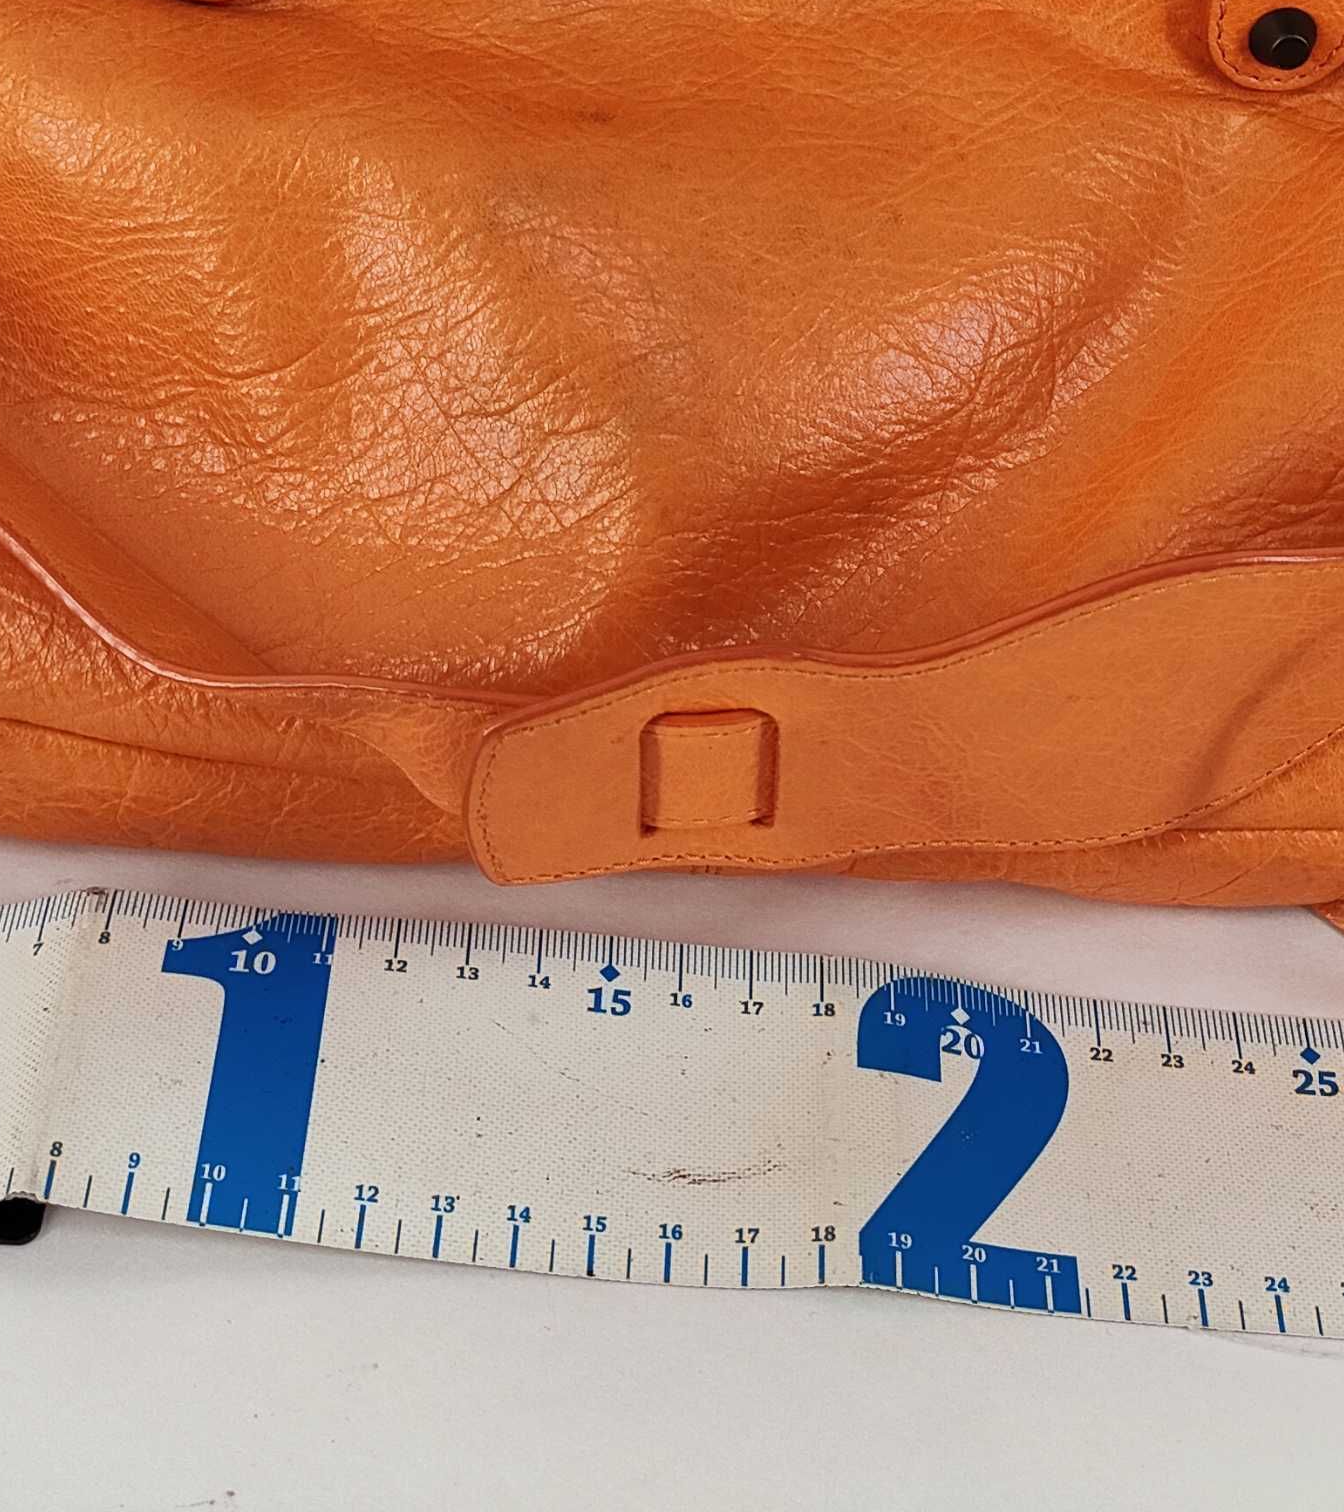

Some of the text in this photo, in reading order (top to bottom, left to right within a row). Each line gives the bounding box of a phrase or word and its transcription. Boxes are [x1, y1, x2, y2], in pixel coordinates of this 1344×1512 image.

[33, 944, 44, 956] 7
[98, 932, 110, 944] 8
[172, 939, 184, 951] 9
[228, 950, 276, 975] 10
[312, 953, 333, 965] 11
[384, 959, 408, 972] 12
[456, 966, 480, 981] 13
[528, 974, 551, 989] 14
[587, 987, 632, 1016] 15
[670, 993, 693, 1008] 16
[740, 1001, 764, 1016] 17
[812, 1003, 836, 1017] 18
[883, 1011, 906, 1026] 19
[939, 1025, 985, 1060] 20
[1020, 1039, 1043, 1054] 21
[1089, 1047, 1114, 1062] 22
[1161, 1054, 1185, 1069] 23
[1231, 1060, 1256, 1074] 24
[1292, 1069, 1340, 1097] 25
[161, 912, 338, 1237] 1
[857, 976, 1082, 1314] 2
[49, 1141, 63, 1157] 8
[127, 1153, 141, 1169] 9
[200, 1164, 226, 1181] 10
[277, 1174, 301, 1192] 11
[353, 1185, 380, 1202] 12
[430, 1195, 456, 1213] 13
[505, 1206, 532, 1224] 14
[582, 1216, 608, 1233] 15
[657, 1224, 684, 1240] 16
[734, 1228, 760, 1244] 17
[811, 1226, 836, 1242] 18
[887, 1231, 913, 1249] 19
[961, 1245, 987, 1263] 20
[1036, 1256, 1061, 1272] 21
[1111, 1264, 1137, 1281] 22
[1188, 1271, 1214, 1287] 23
[1264, 1277, 1291, 1293] 24
